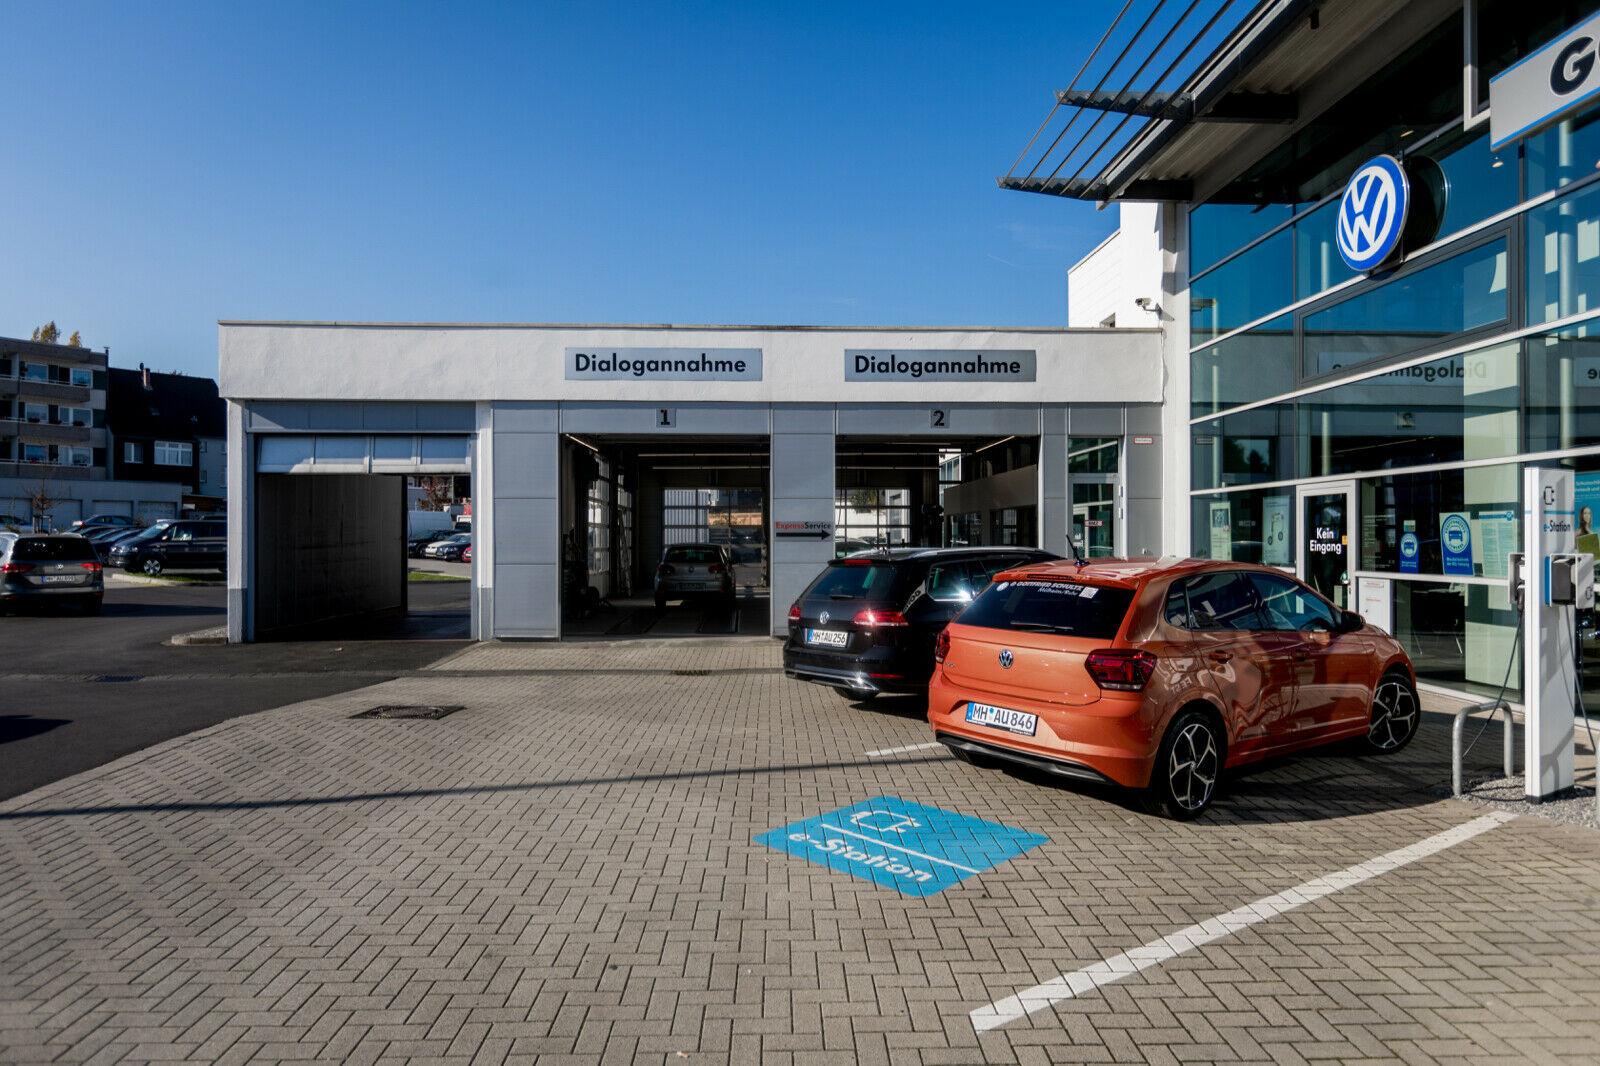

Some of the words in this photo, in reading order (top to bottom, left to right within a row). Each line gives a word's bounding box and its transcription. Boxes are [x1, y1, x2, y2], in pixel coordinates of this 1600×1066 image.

[1550, 36, 1600, 95] G
[575, 352, 747, 377] Dialogannahme
[854, 354, 1022, 378] Dialogannahme
[660, 409, 671, 426] 1
[932, 410, 945, 427] 2
[1316, 527, 1334, 540] Kein
[1309, 540, 1342, 555] Eingang
[972, 704, 989, 721] MH
[789, 833, 933, 882] e-Station
